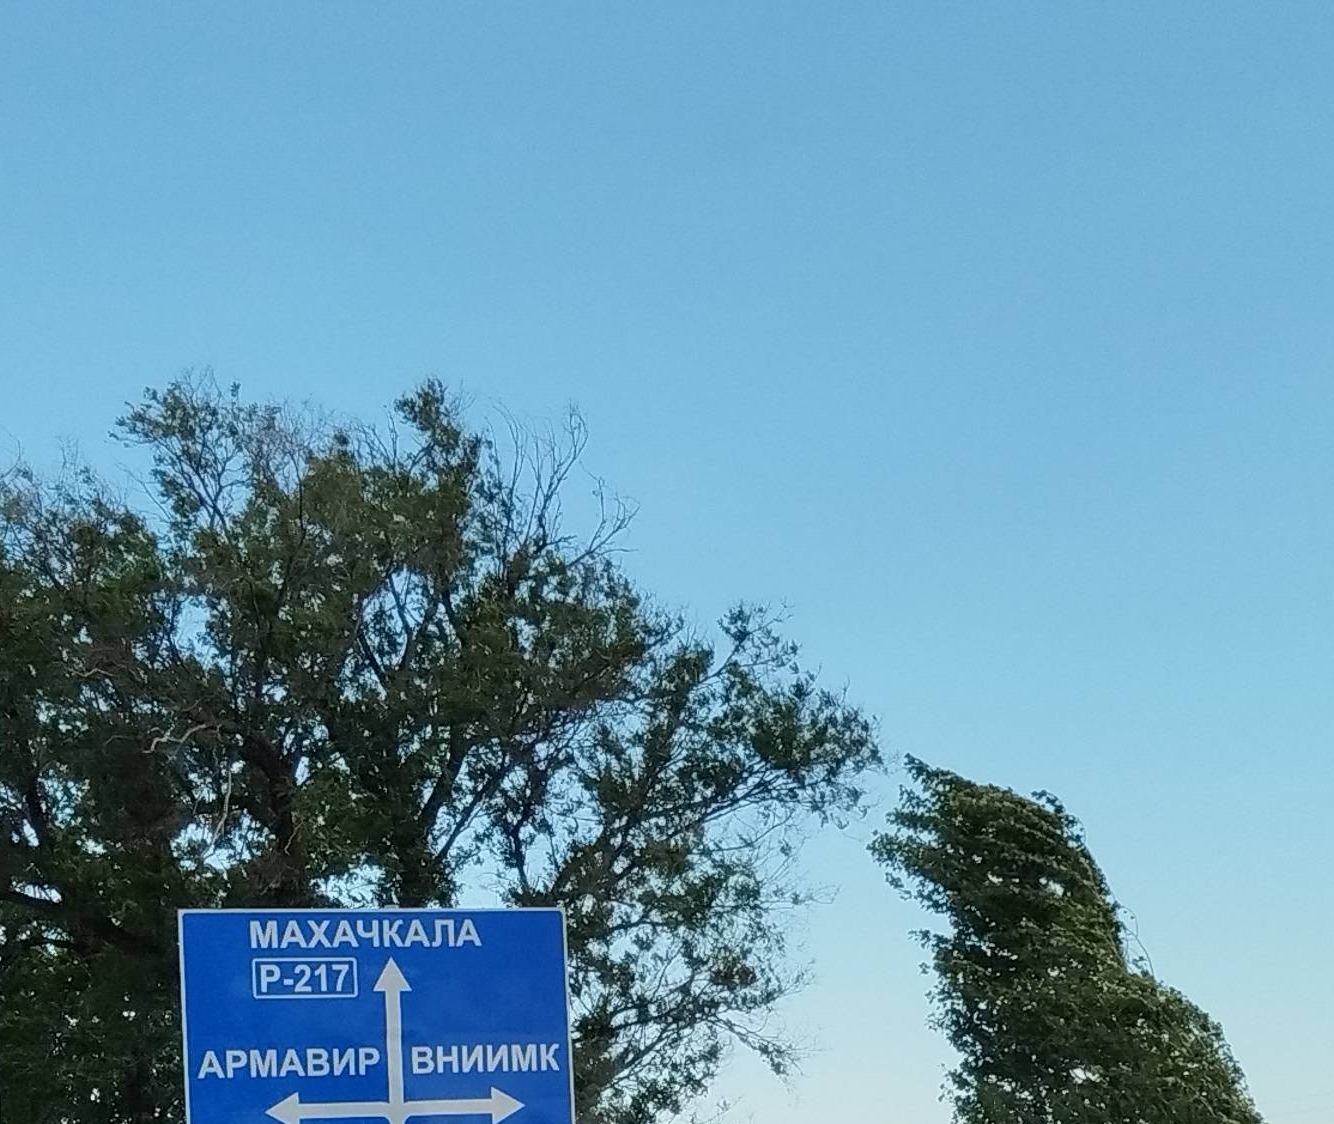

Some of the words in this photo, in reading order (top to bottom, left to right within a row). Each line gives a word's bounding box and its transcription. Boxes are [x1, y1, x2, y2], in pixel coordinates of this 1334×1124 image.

[249, 919, 483, 949] МАХАЧКАЛА
[259, 964, 351, 993] Р-217
[197, 1048, 381, 1080] АРМАВИР
[411, 1044, 561, 1073] ВНИИМК
